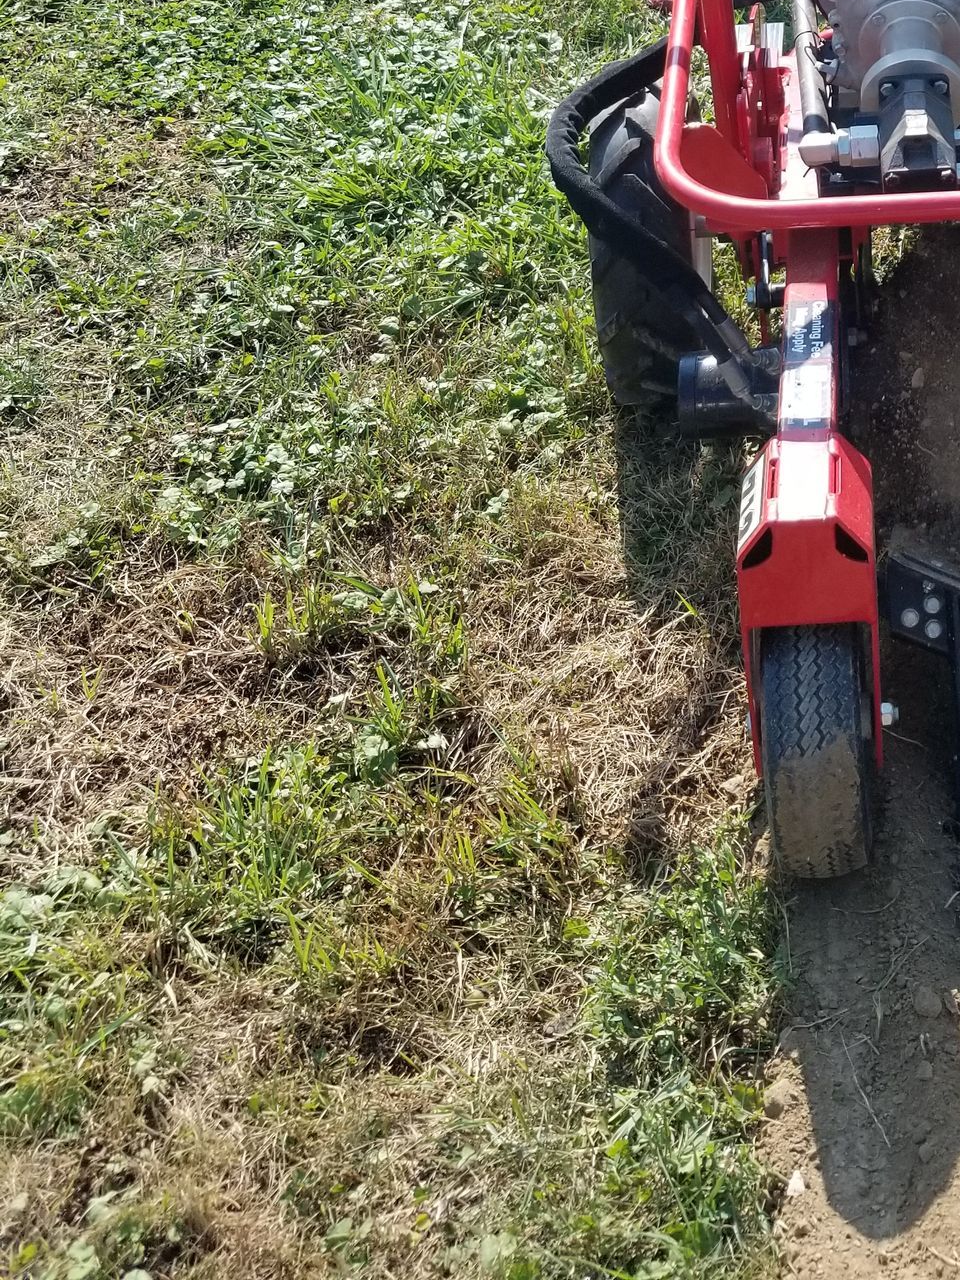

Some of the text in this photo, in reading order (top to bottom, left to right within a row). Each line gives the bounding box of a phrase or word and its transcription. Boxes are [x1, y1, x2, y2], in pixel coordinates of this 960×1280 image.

[791, 327, 808, 353] Apply
[809, 300, 825, 359] Cleaning Fee
